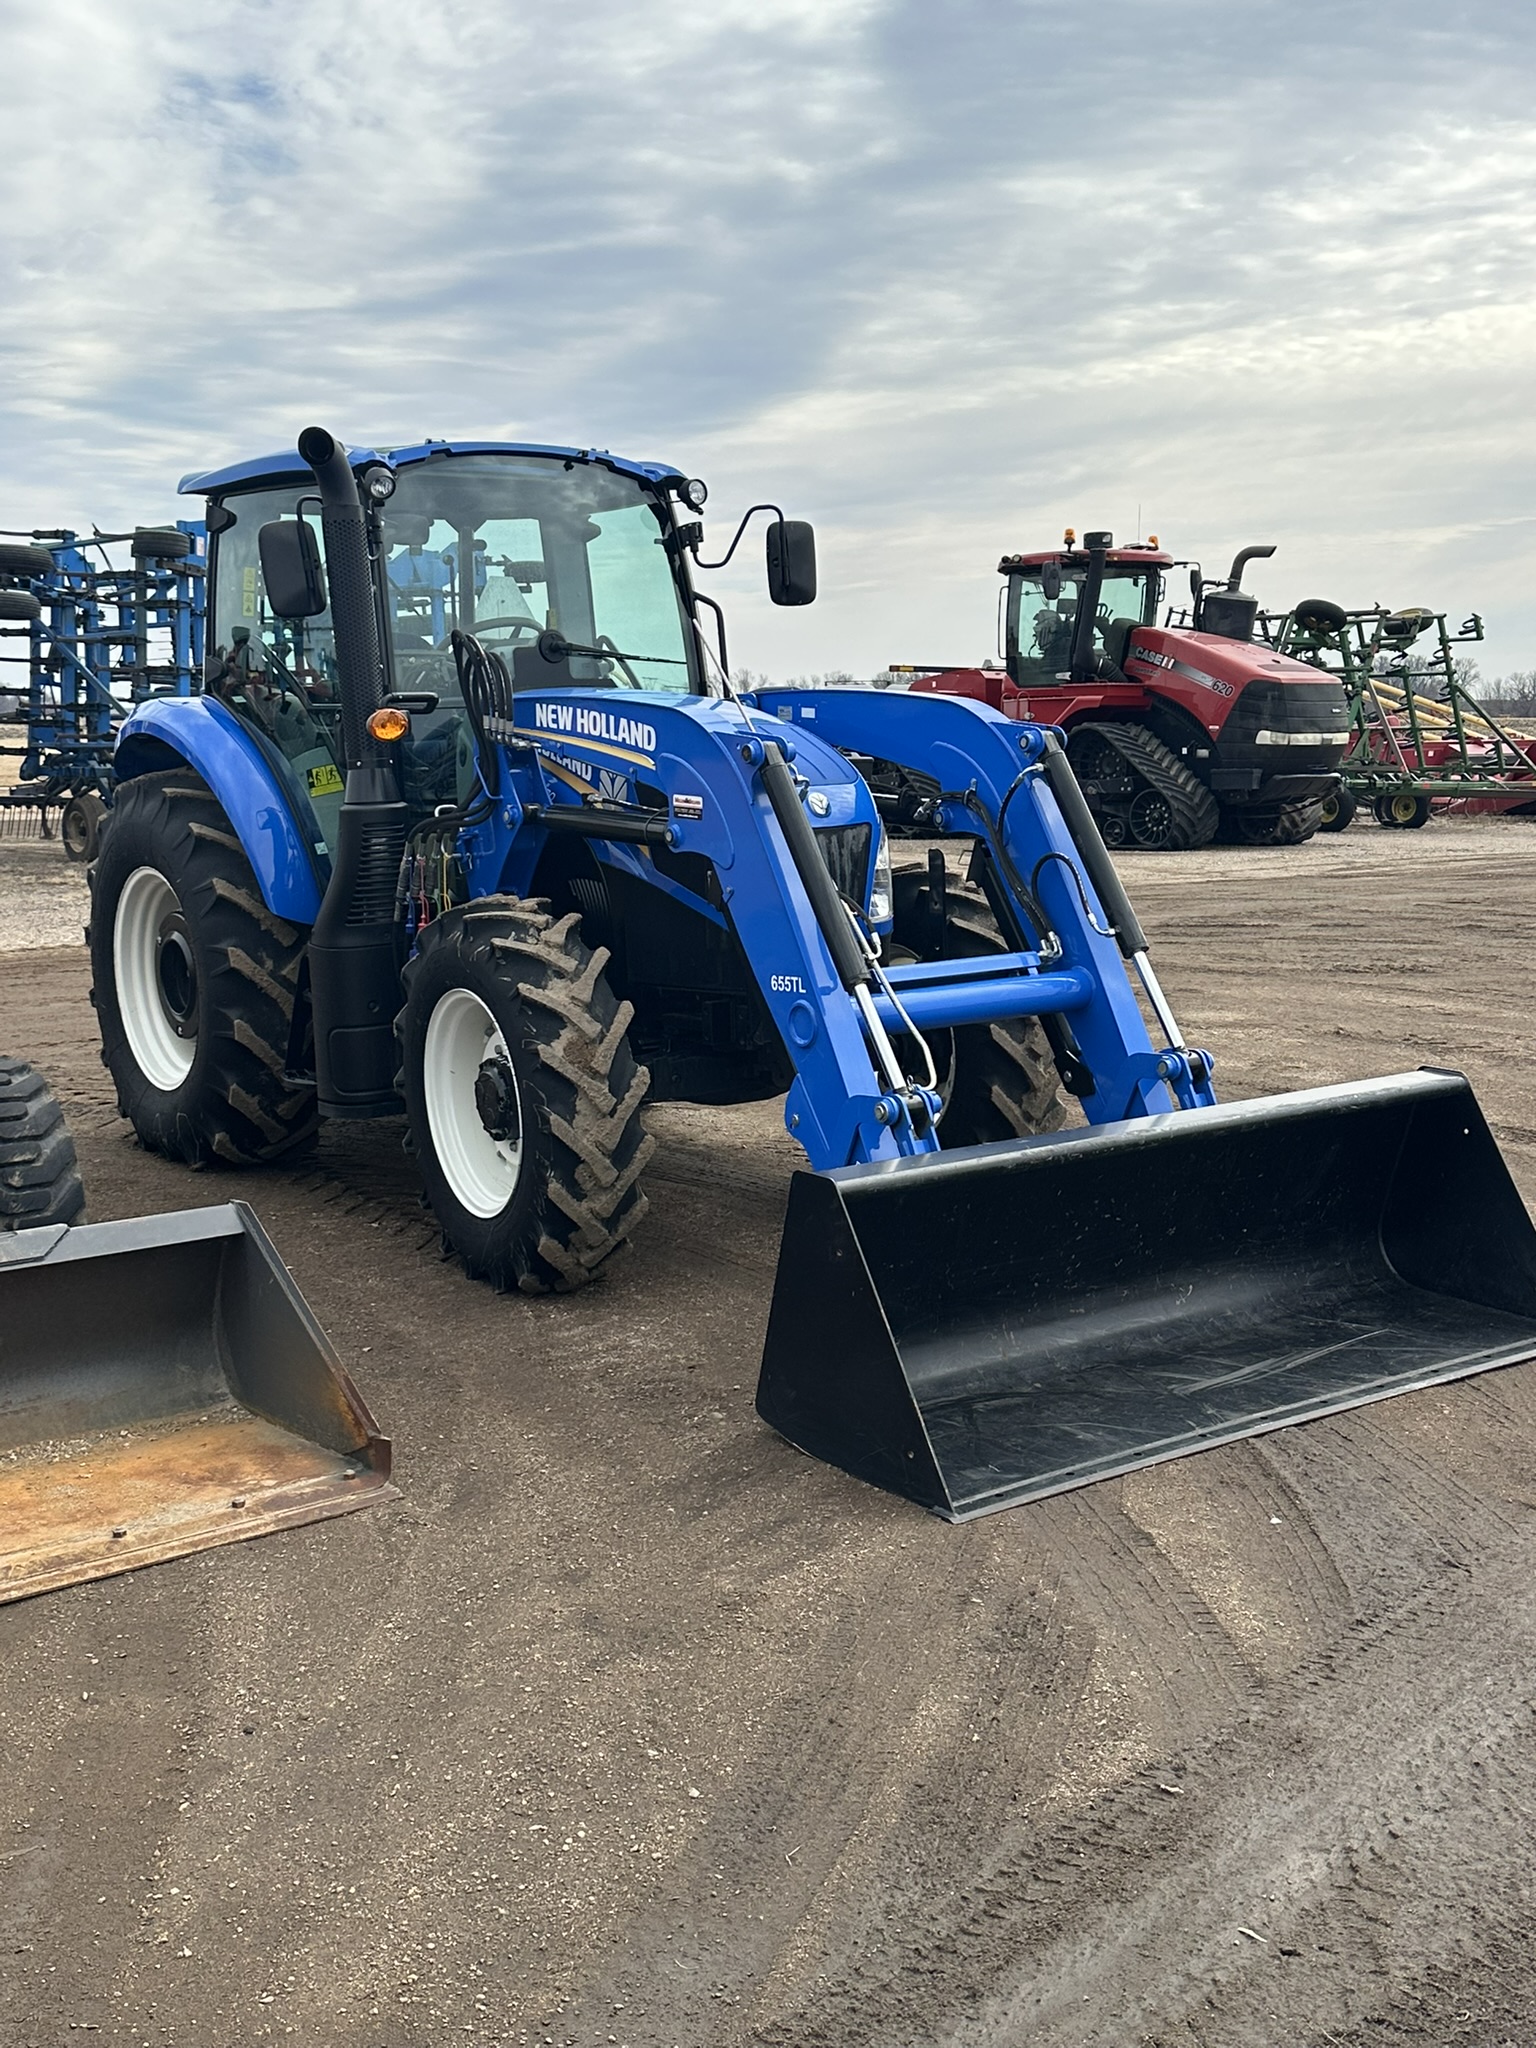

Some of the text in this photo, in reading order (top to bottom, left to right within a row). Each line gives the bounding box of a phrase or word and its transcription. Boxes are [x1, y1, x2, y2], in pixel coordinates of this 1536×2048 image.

[1212, 680, 1234, 697] 620
[535, 703, 657, 752] NEW HOLLAND
[771, 975, 806, 993] 655TL
